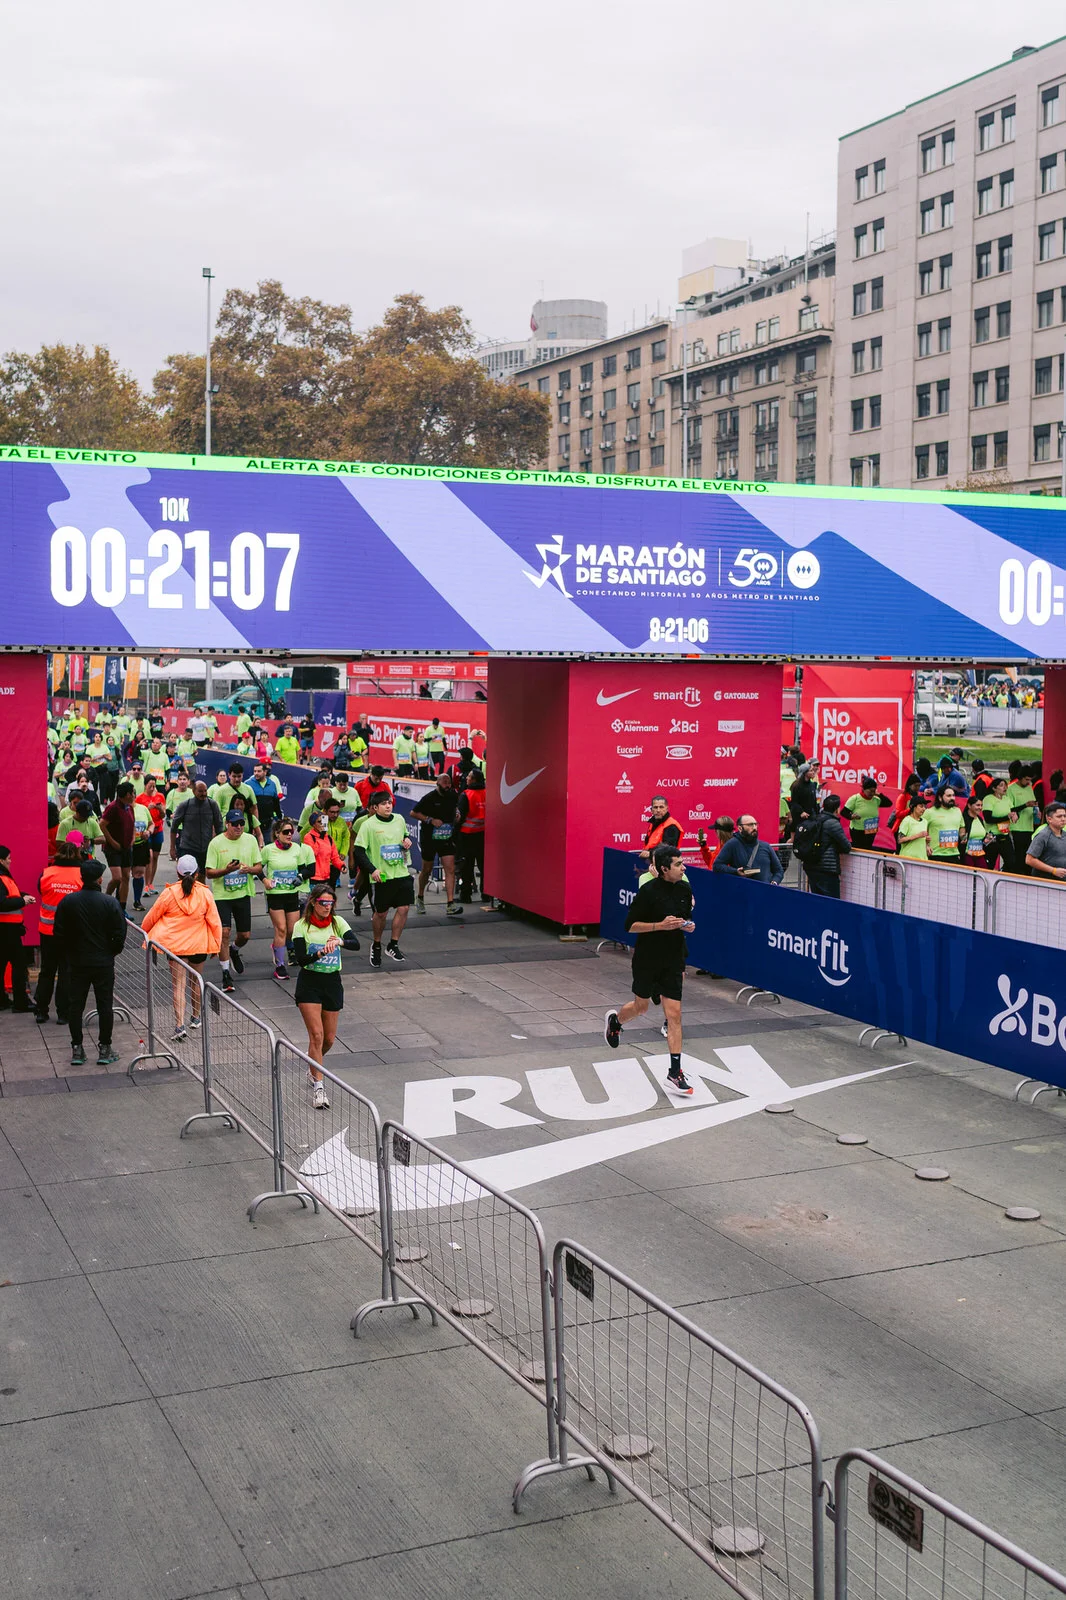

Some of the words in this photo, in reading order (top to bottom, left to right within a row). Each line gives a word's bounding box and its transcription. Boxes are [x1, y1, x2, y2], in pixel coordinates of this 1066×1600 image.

[27, 449, 51, 460] EL
[55, 450, 137, 463] EVENTO
[246, 459, 319, 472] ALERTA
[324, 463, 367, 474] SAE:
[371, 465, 501, 480] CONDICIONES
[506, 469, 590, 485] ÓPTIMAS,
[596, 475, 678, 489] DISFRUTA
[682, 479, 702, 489] EL
[703, 481, 769, 493] EVENTO.
[159, 496, 190, 522] 10K
[576, 541, 705, 569] MARATÓN
[50, 525, 300, 612] 00:21:07
[575, 566, 603, 584] DE
[606, 567, 707, 587] SANTIAGO
[576, 589, 637, 597] CONECTANDO
[705, 592, 728, 600] AÑOS
[649, 617, 709, 644] 8:21:06
[723, 692, 759, 700] GATORADE
[823, 708, 850, 727] No
[623, 724, 659, 732] Alemana
[823, 726, 894, 746] Prokart
[616, 745, 643, 754] Eucerin
[714, 746, 738, 758] SKY
[822, 747, 850, 765] No
[656, 778, 689, 787] ACUVUE
[703, 778, 738, 787] SUBWAY
[402, 1044, 793, 1140] RUN
